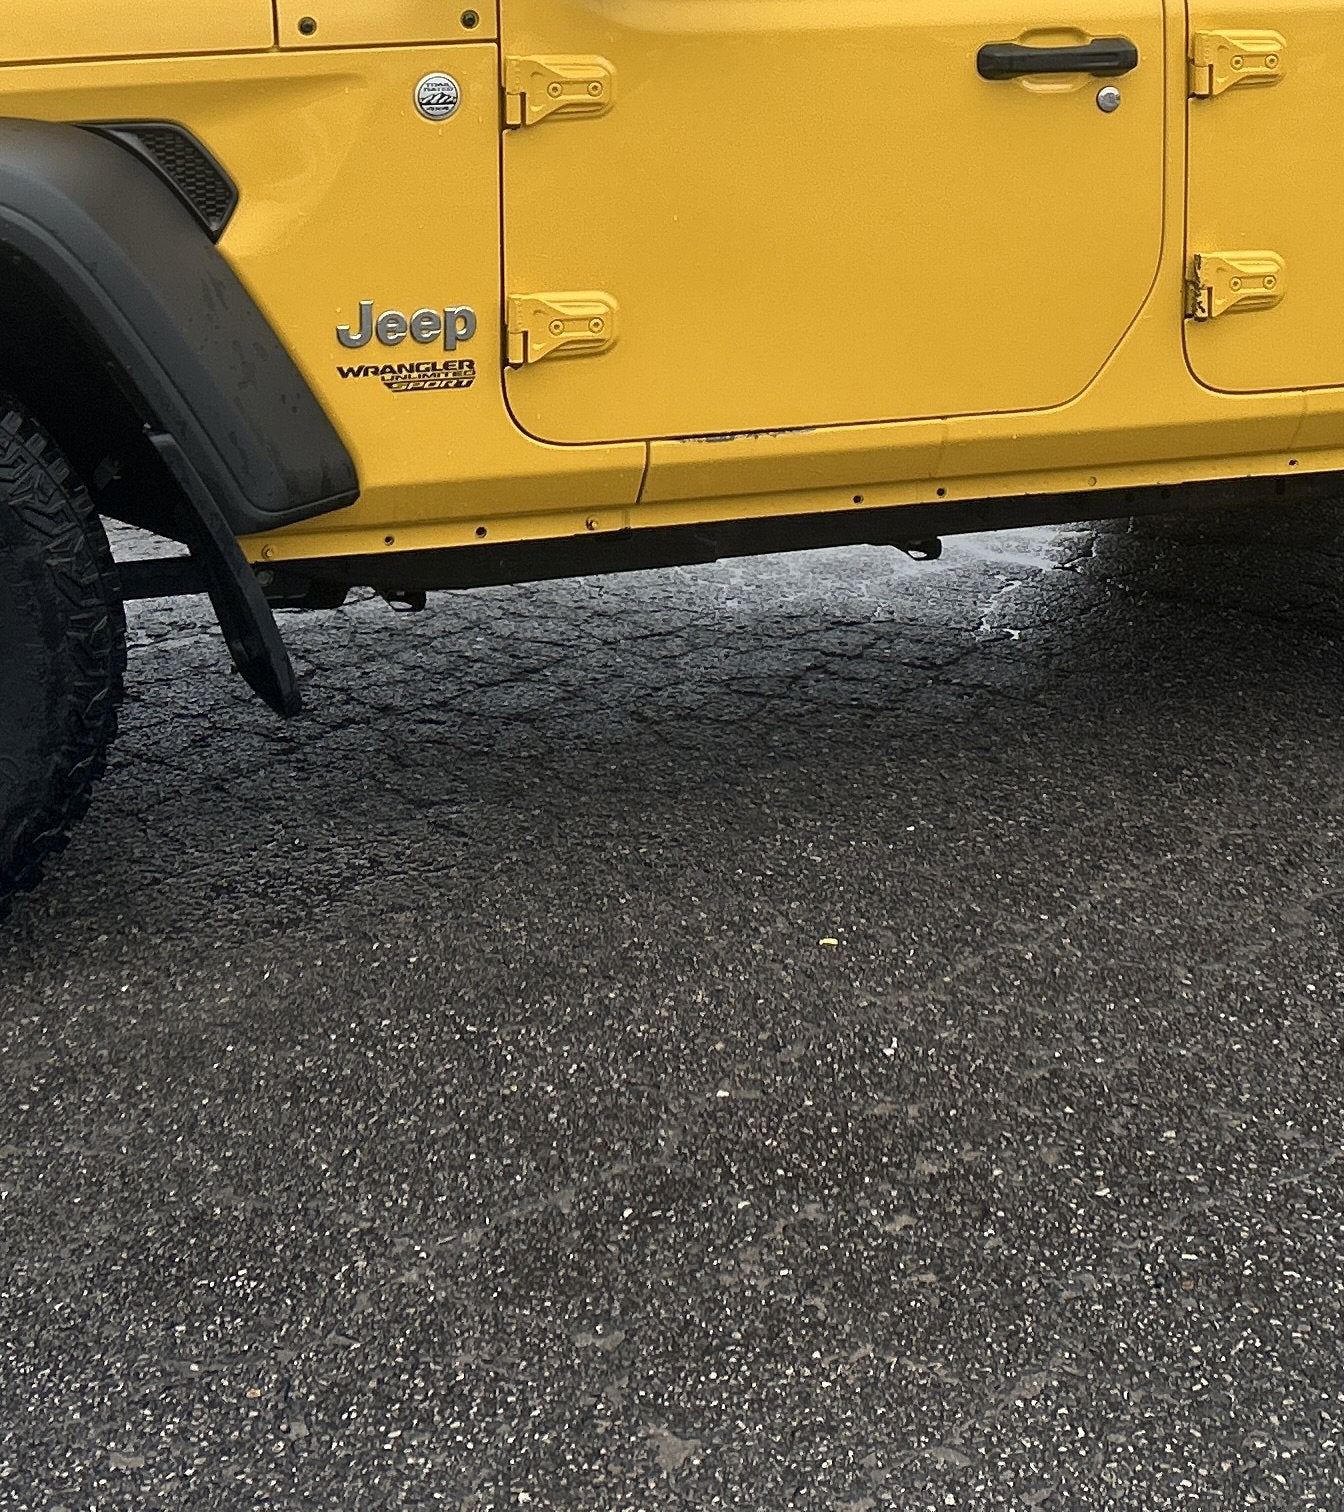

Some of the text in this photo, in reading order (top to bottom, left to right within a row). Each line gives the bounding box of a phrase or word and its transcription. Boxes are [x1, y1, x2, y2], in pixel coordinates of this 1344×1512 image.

[336, 300, 476, 351] Jeep
[336, 359, 476, 379] WRANGLER
[381, 370, 476, 382] UNLIMITED
[392, 379, 473, 390] SPORT
